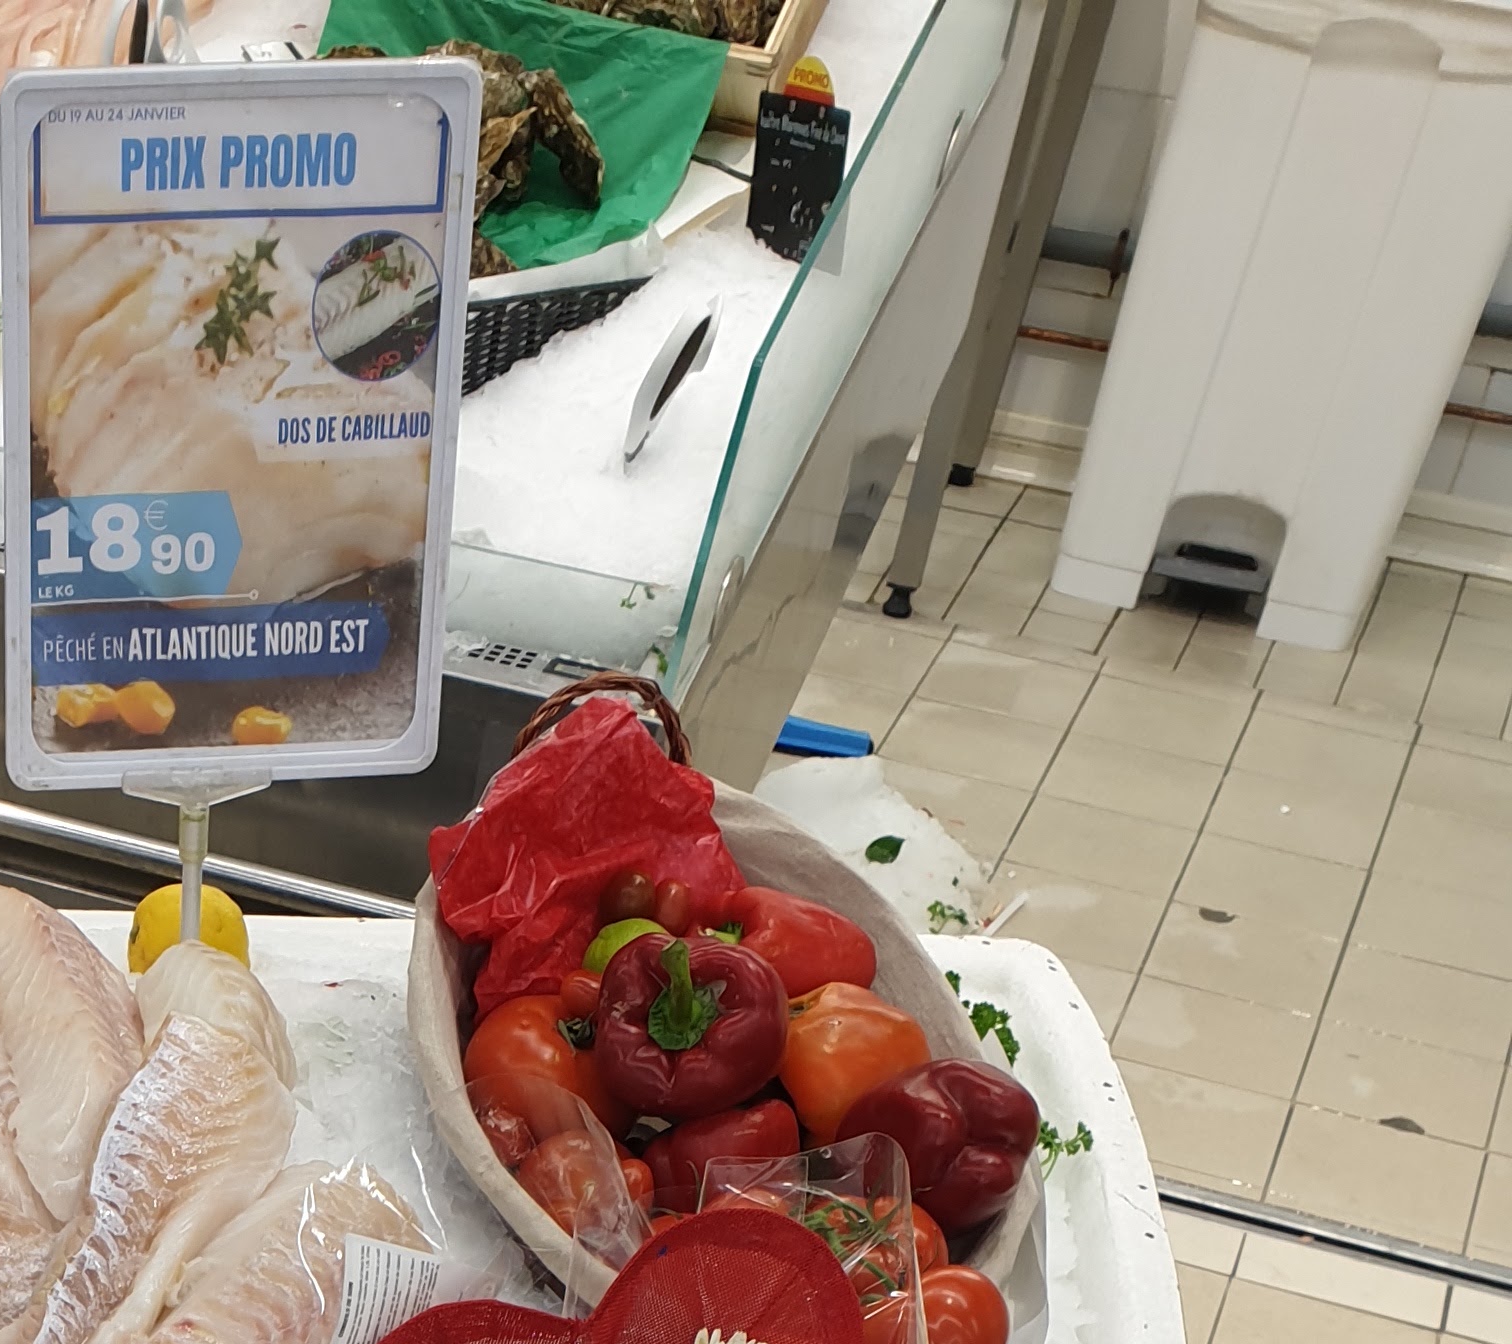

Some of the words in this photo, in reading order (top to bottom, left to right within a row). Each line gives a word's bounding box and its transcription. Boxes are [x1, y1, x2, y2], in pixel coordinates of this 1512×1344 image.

[48, 108, 66, 122] DU
[70, 108, 82, 122] 19
[85, 108, 104, 121] AU
[108, 107, 124, 121] 24
[128, 106, 186, 121] JANVIER
[121, 135, 207, 192] PRIX
[219, 132, 357, 190] PROMO
[278, 416, 311, 445] DOS
[316, 415, 337, 444] DE
[341, 411, 431, 442] CABILLAUD
[35, 502, 142, 576] 18
[150, 531, 216, 575] 90
[38, 587, 53, 599] LE
[55, 584, 75, 598] KG
[43, 632, 97, 662] PÊCHÉ
[103, 635, 124, 661] EN
[128, 622, 258, 662] ATLANTIQUE
[264, 620, 324, 657] NORD
[329, 618, 370, 654] EST
